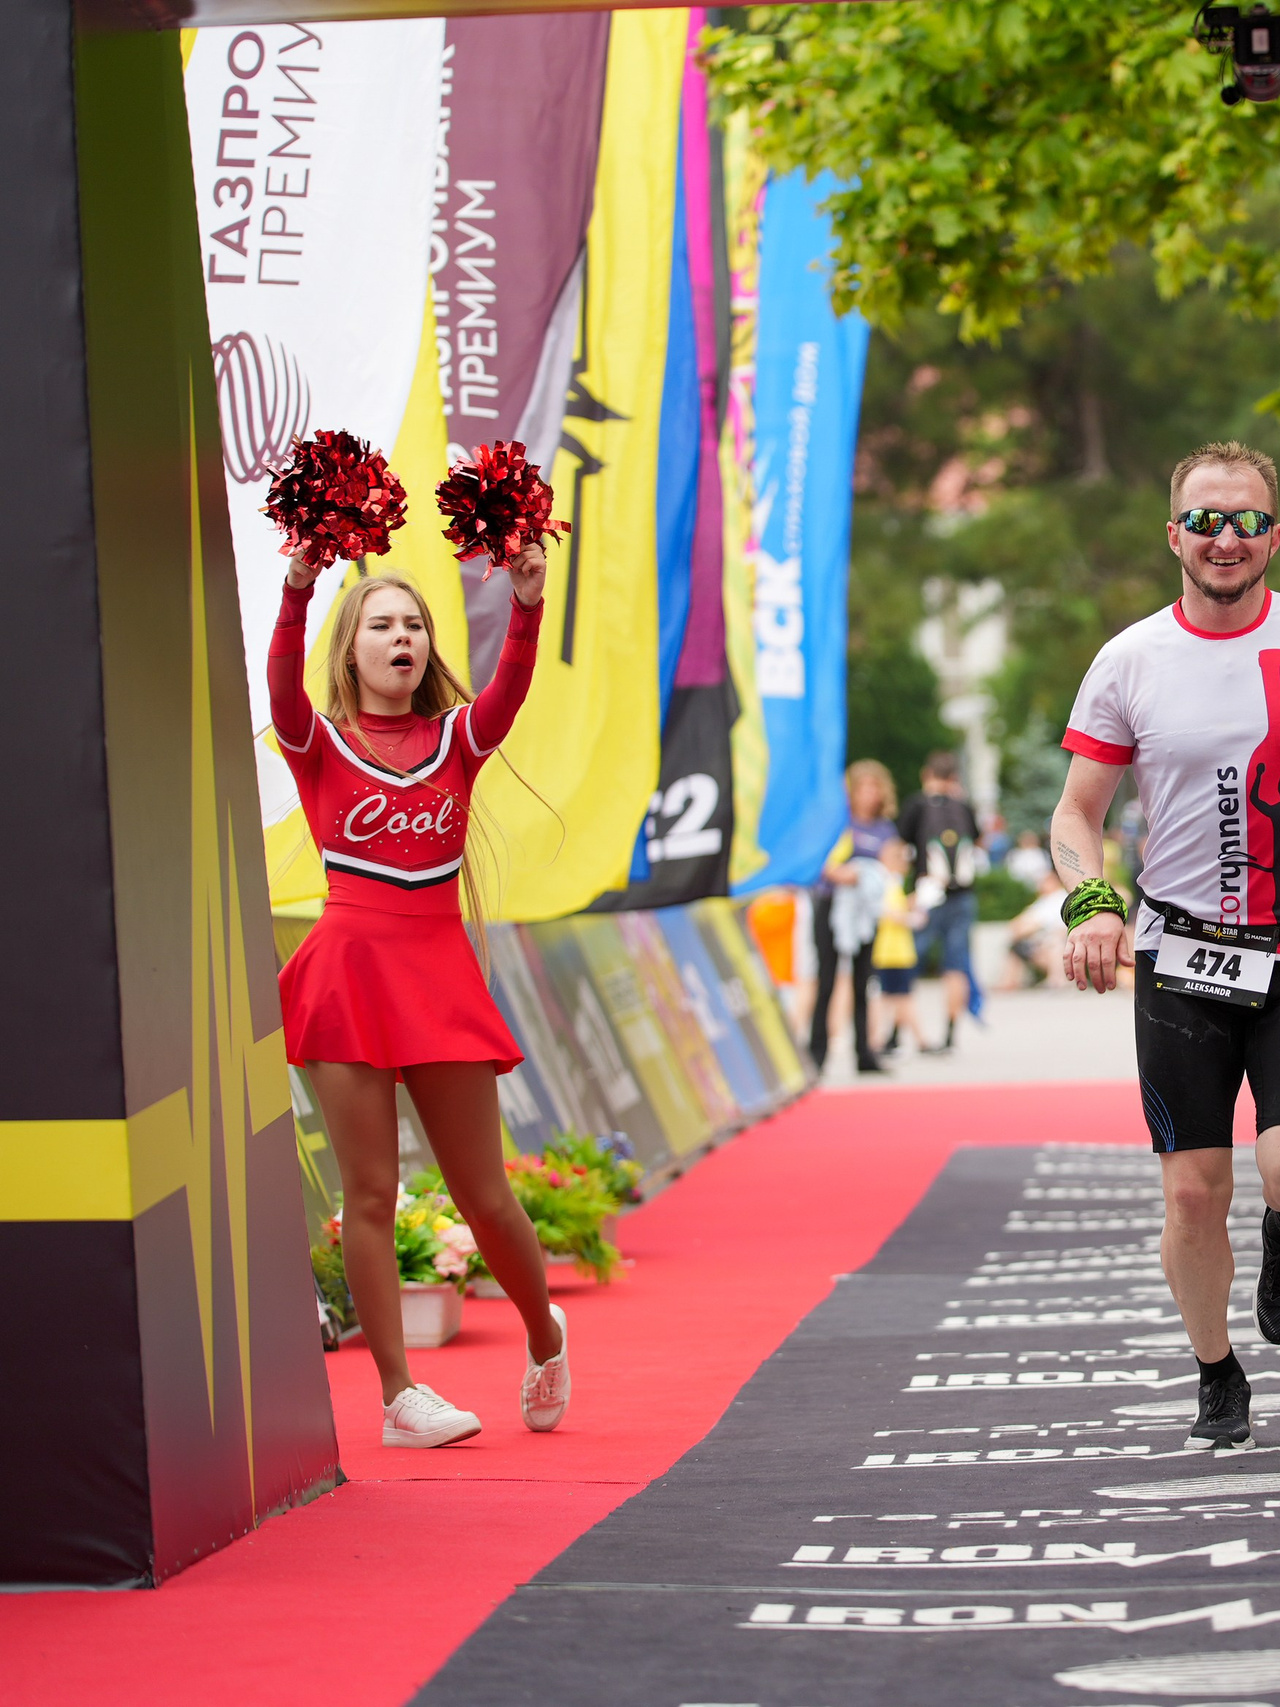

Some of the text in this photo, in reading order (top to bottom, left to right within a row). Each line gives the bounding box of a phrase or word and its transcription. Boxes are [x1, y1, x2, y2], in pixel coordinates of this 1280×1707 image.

[454, 179, 500, 419] ПРЕМИУМ
[343, 793, 455, 842] Cool
[1202, 922, 1217, 932] IRON
[1221, 927, 1238, 936] STAR
[1186, 947, 1242, 981] 474
[1184, 981, 1232, 998] ALEKSANDR
[909, 1369, 1159, 1387] IRON
[863, 1446, 1150, 1465] IRON
[792, 1541, 1136, 1562] IRON
[750, 1602, 1127, 1624] IRON
